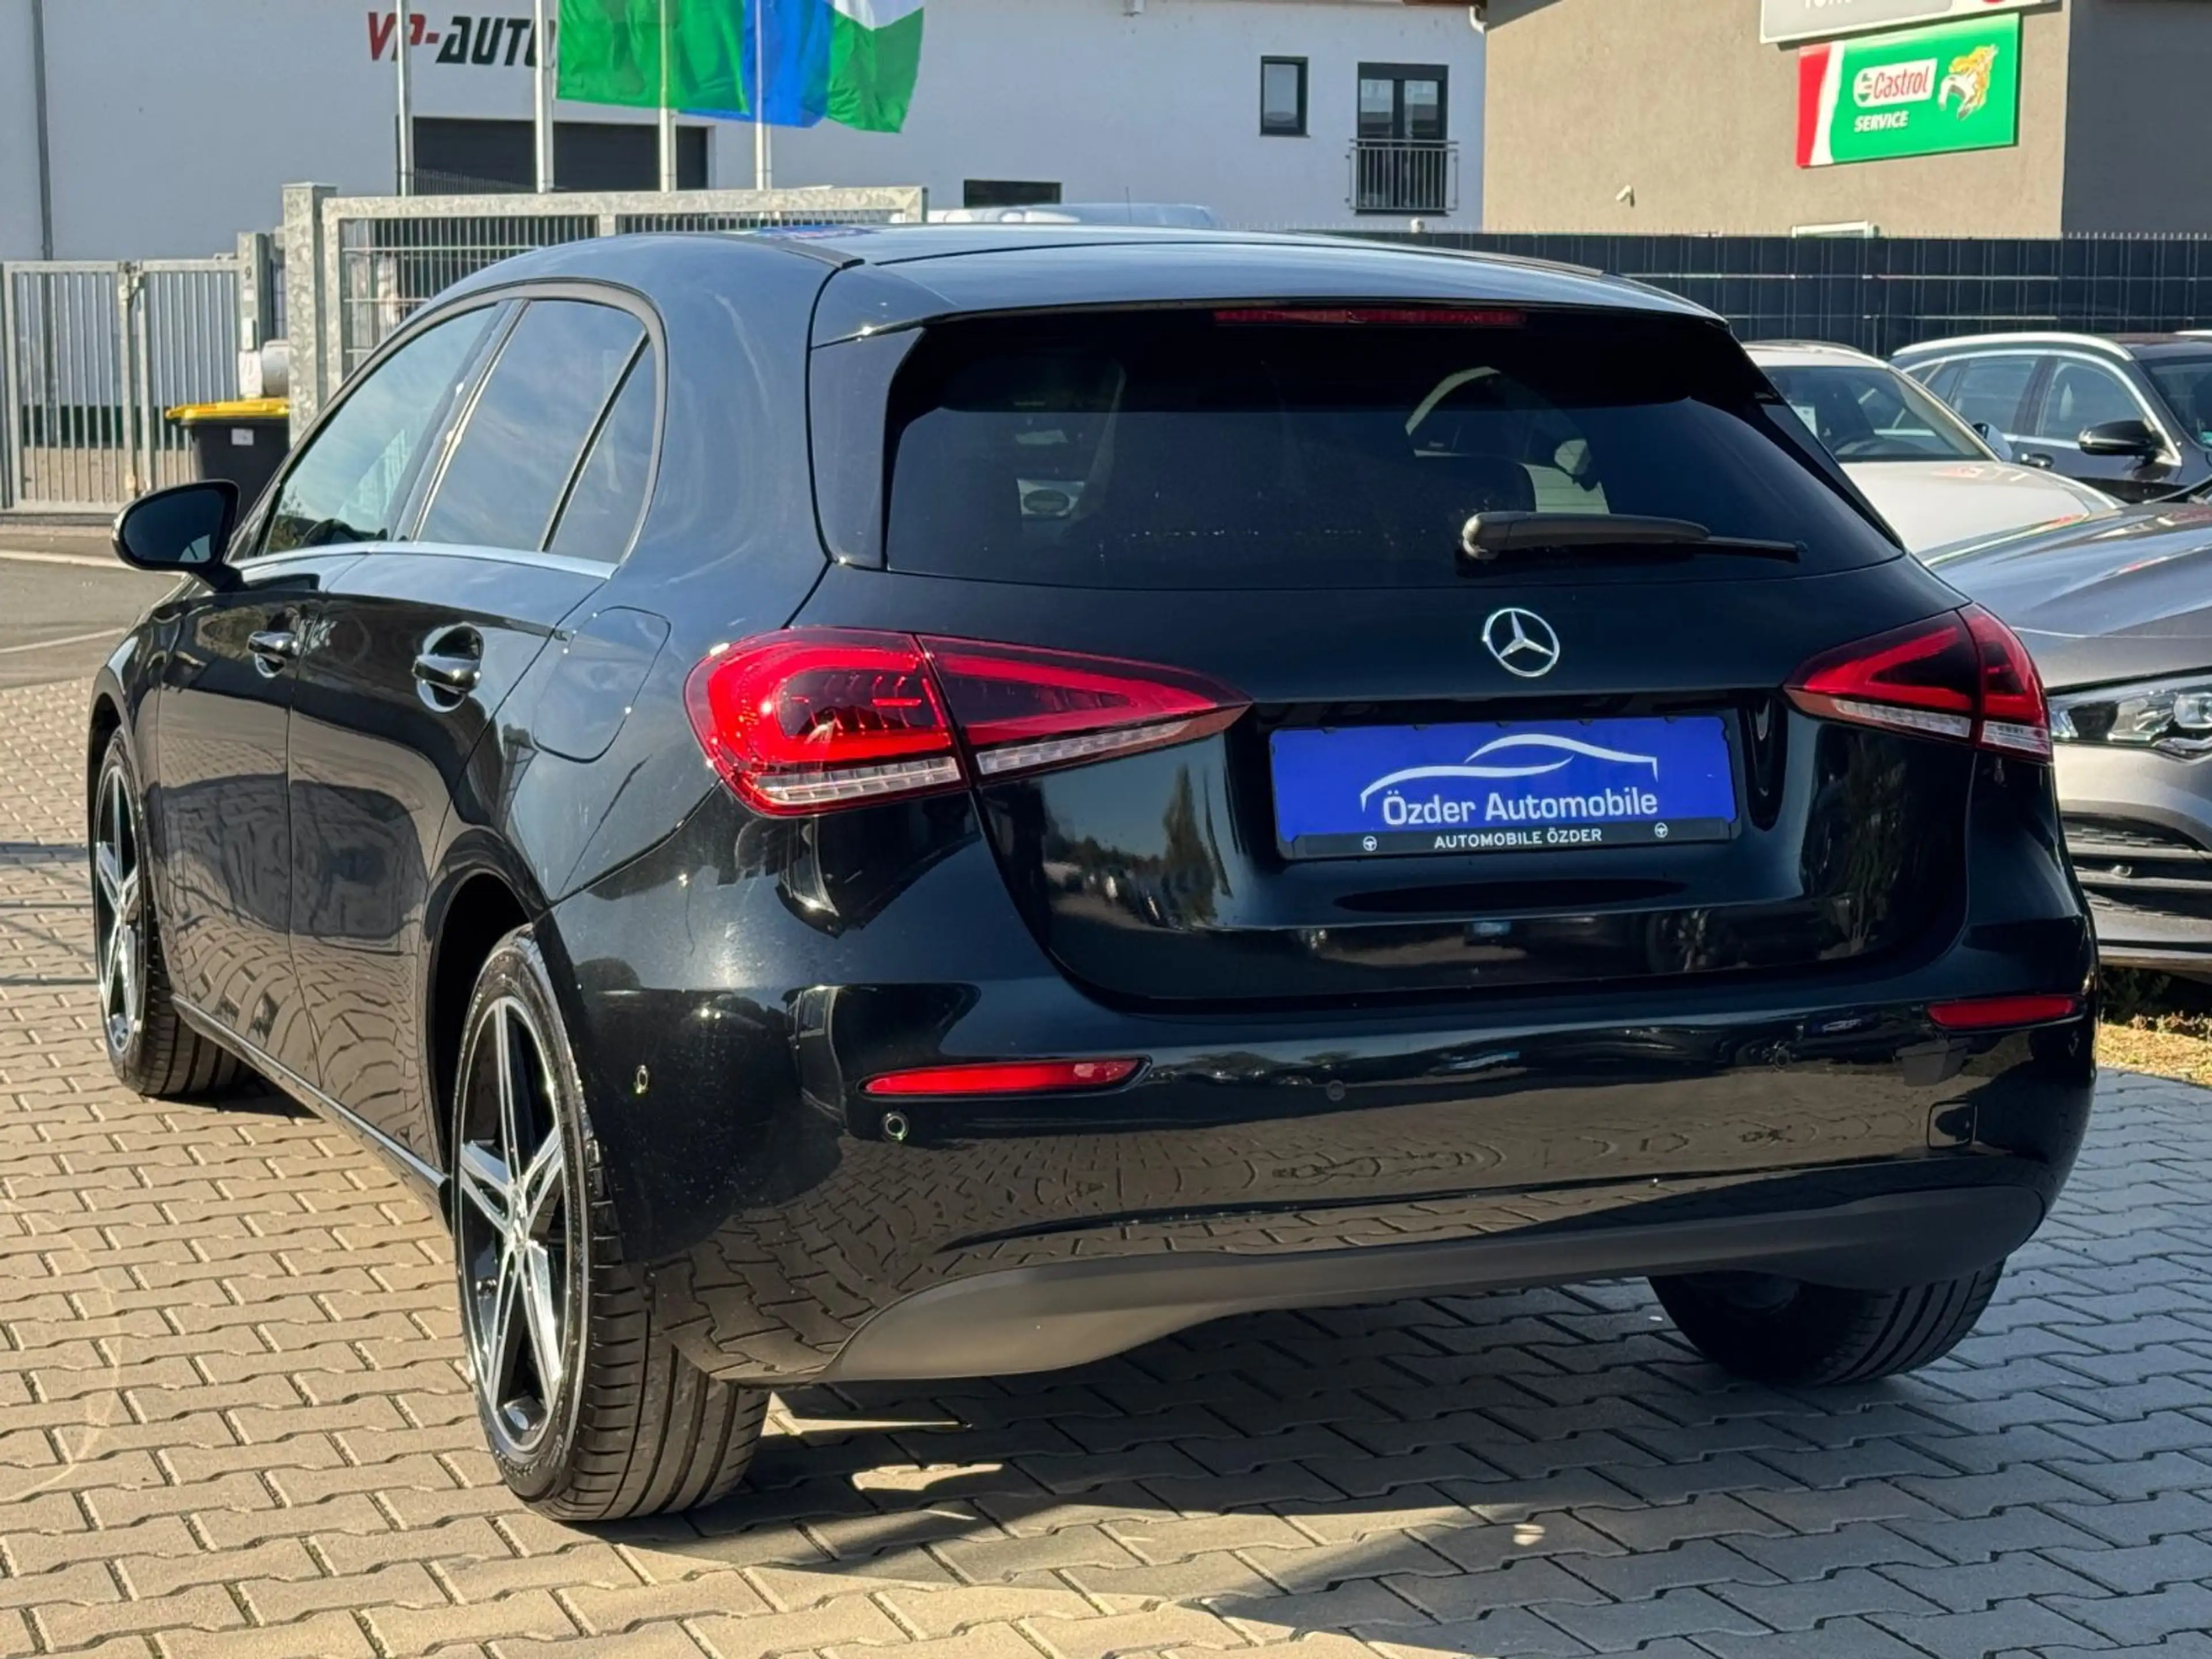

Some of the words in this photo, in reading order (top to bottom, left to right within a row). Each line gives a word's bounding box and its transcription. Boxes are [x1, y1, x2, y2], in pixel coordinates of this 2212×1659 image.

[1873, 66, 1930, 99] Castrol
[1854, 111, 1909, 132] SERVICE
[1384, 790, 1475, 825] Özder
[1486, 787, 1658, 821] Automobile
[1434, 832, 1542, 849] AUTOMOBILE
[1548, 827, 1603, 844] ÖZDER
